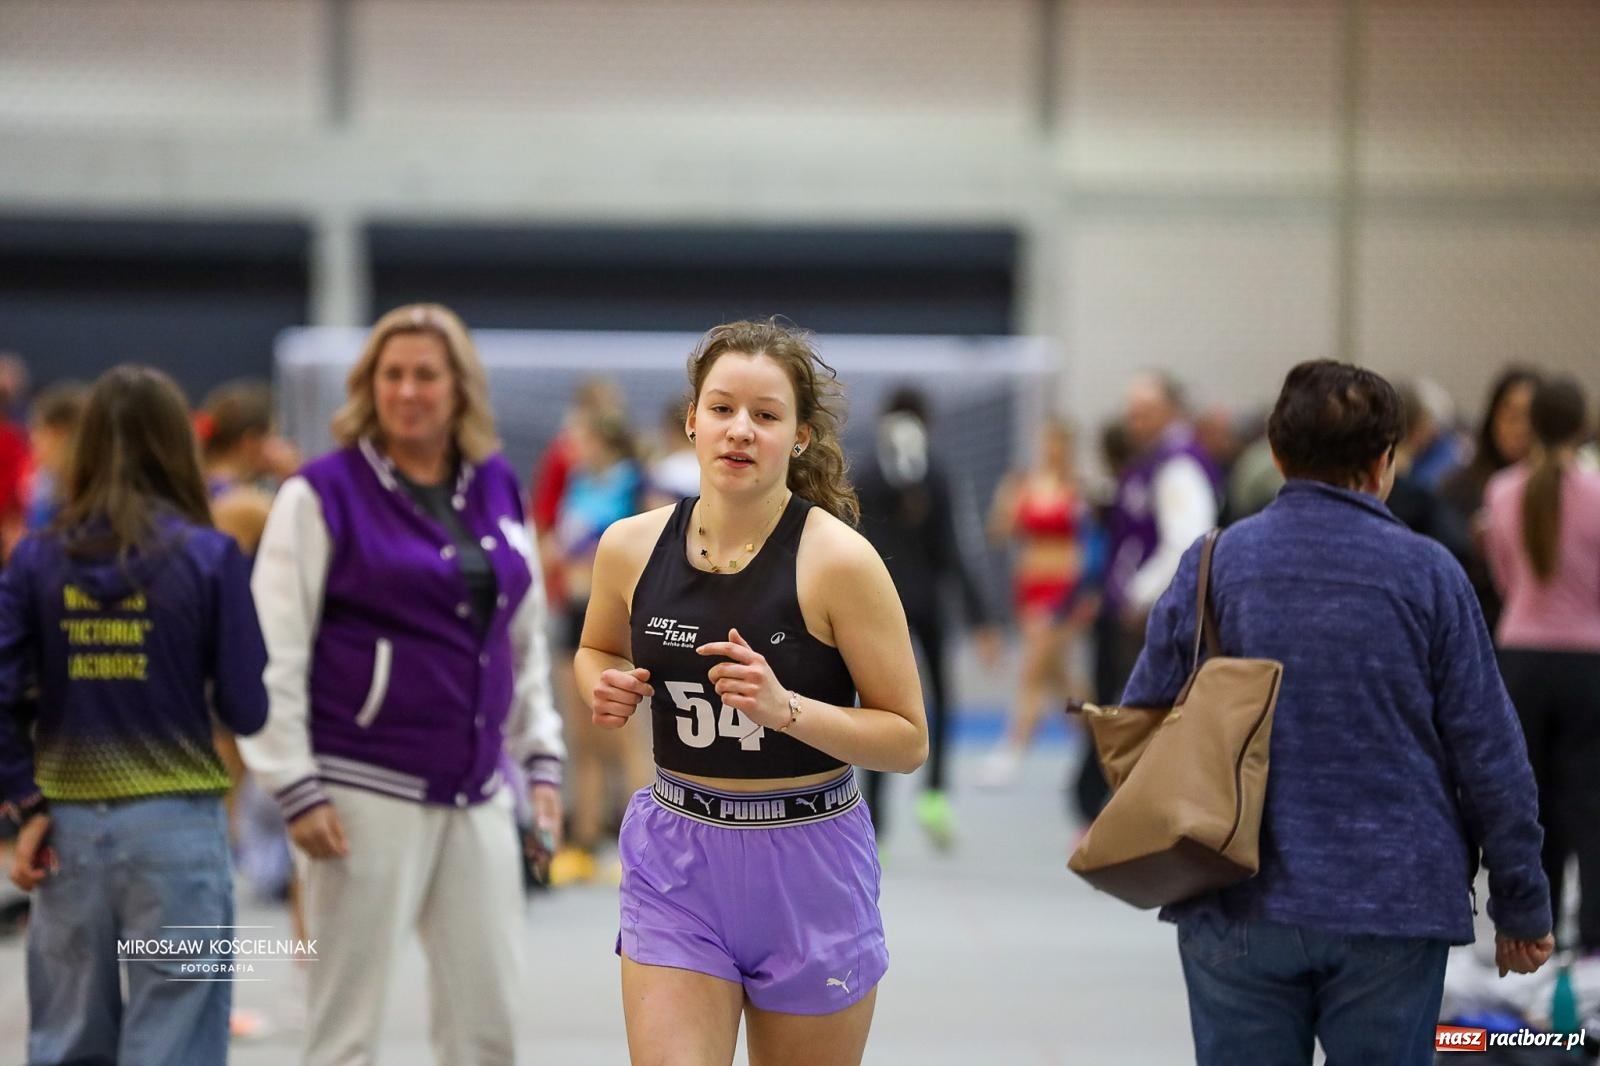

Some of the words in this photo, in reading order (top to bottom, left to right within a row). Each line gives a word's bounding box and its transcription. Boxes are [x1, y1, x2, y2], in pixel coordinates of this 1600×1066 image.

[647, 616, 677, 630] JUST
[664, 630, 697, 643] TEAM
[664, 680, 765, 751] 54
[720, 799, 786, 820] PUMA
